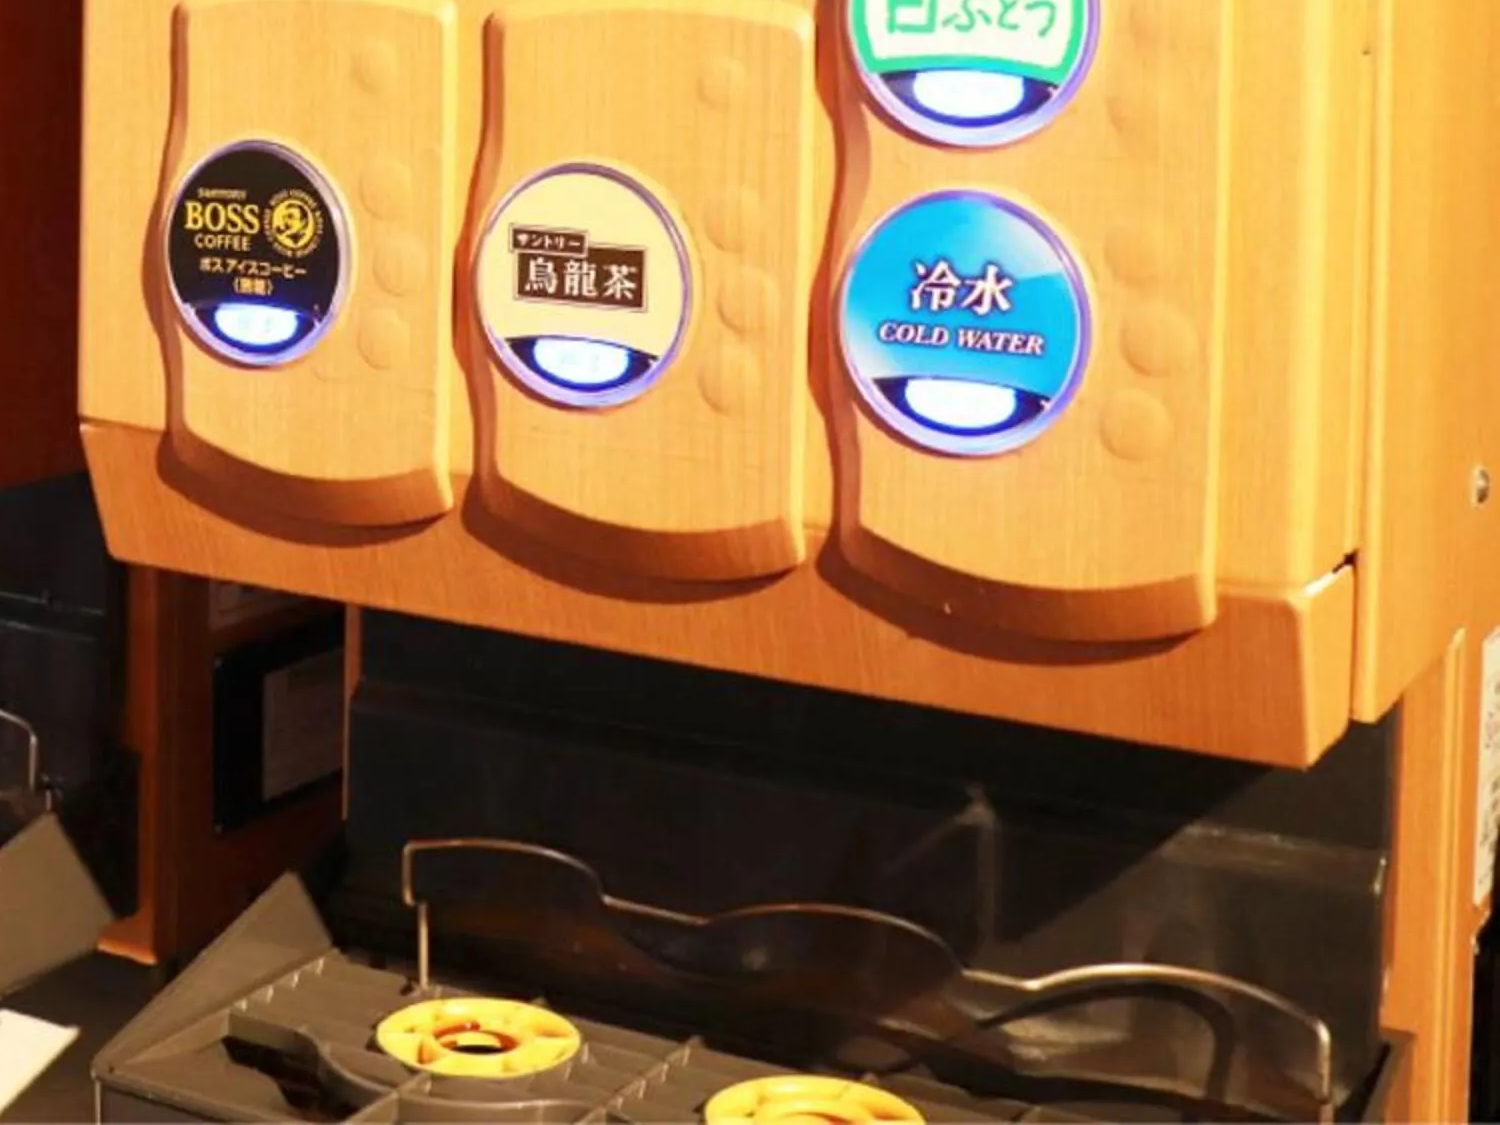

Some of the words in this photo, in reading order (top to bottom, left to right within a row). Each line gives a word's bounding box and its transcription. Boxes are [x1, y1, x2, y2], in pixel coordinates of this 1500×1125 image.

[184, 200, 261, 235] BOSS
[194, 233, 252, 252] COFFEE
[910, 259, 1014, 316] 冷水
[879, 322, 950, 346] COLD
[957, 327, 1045, 356] WATER
